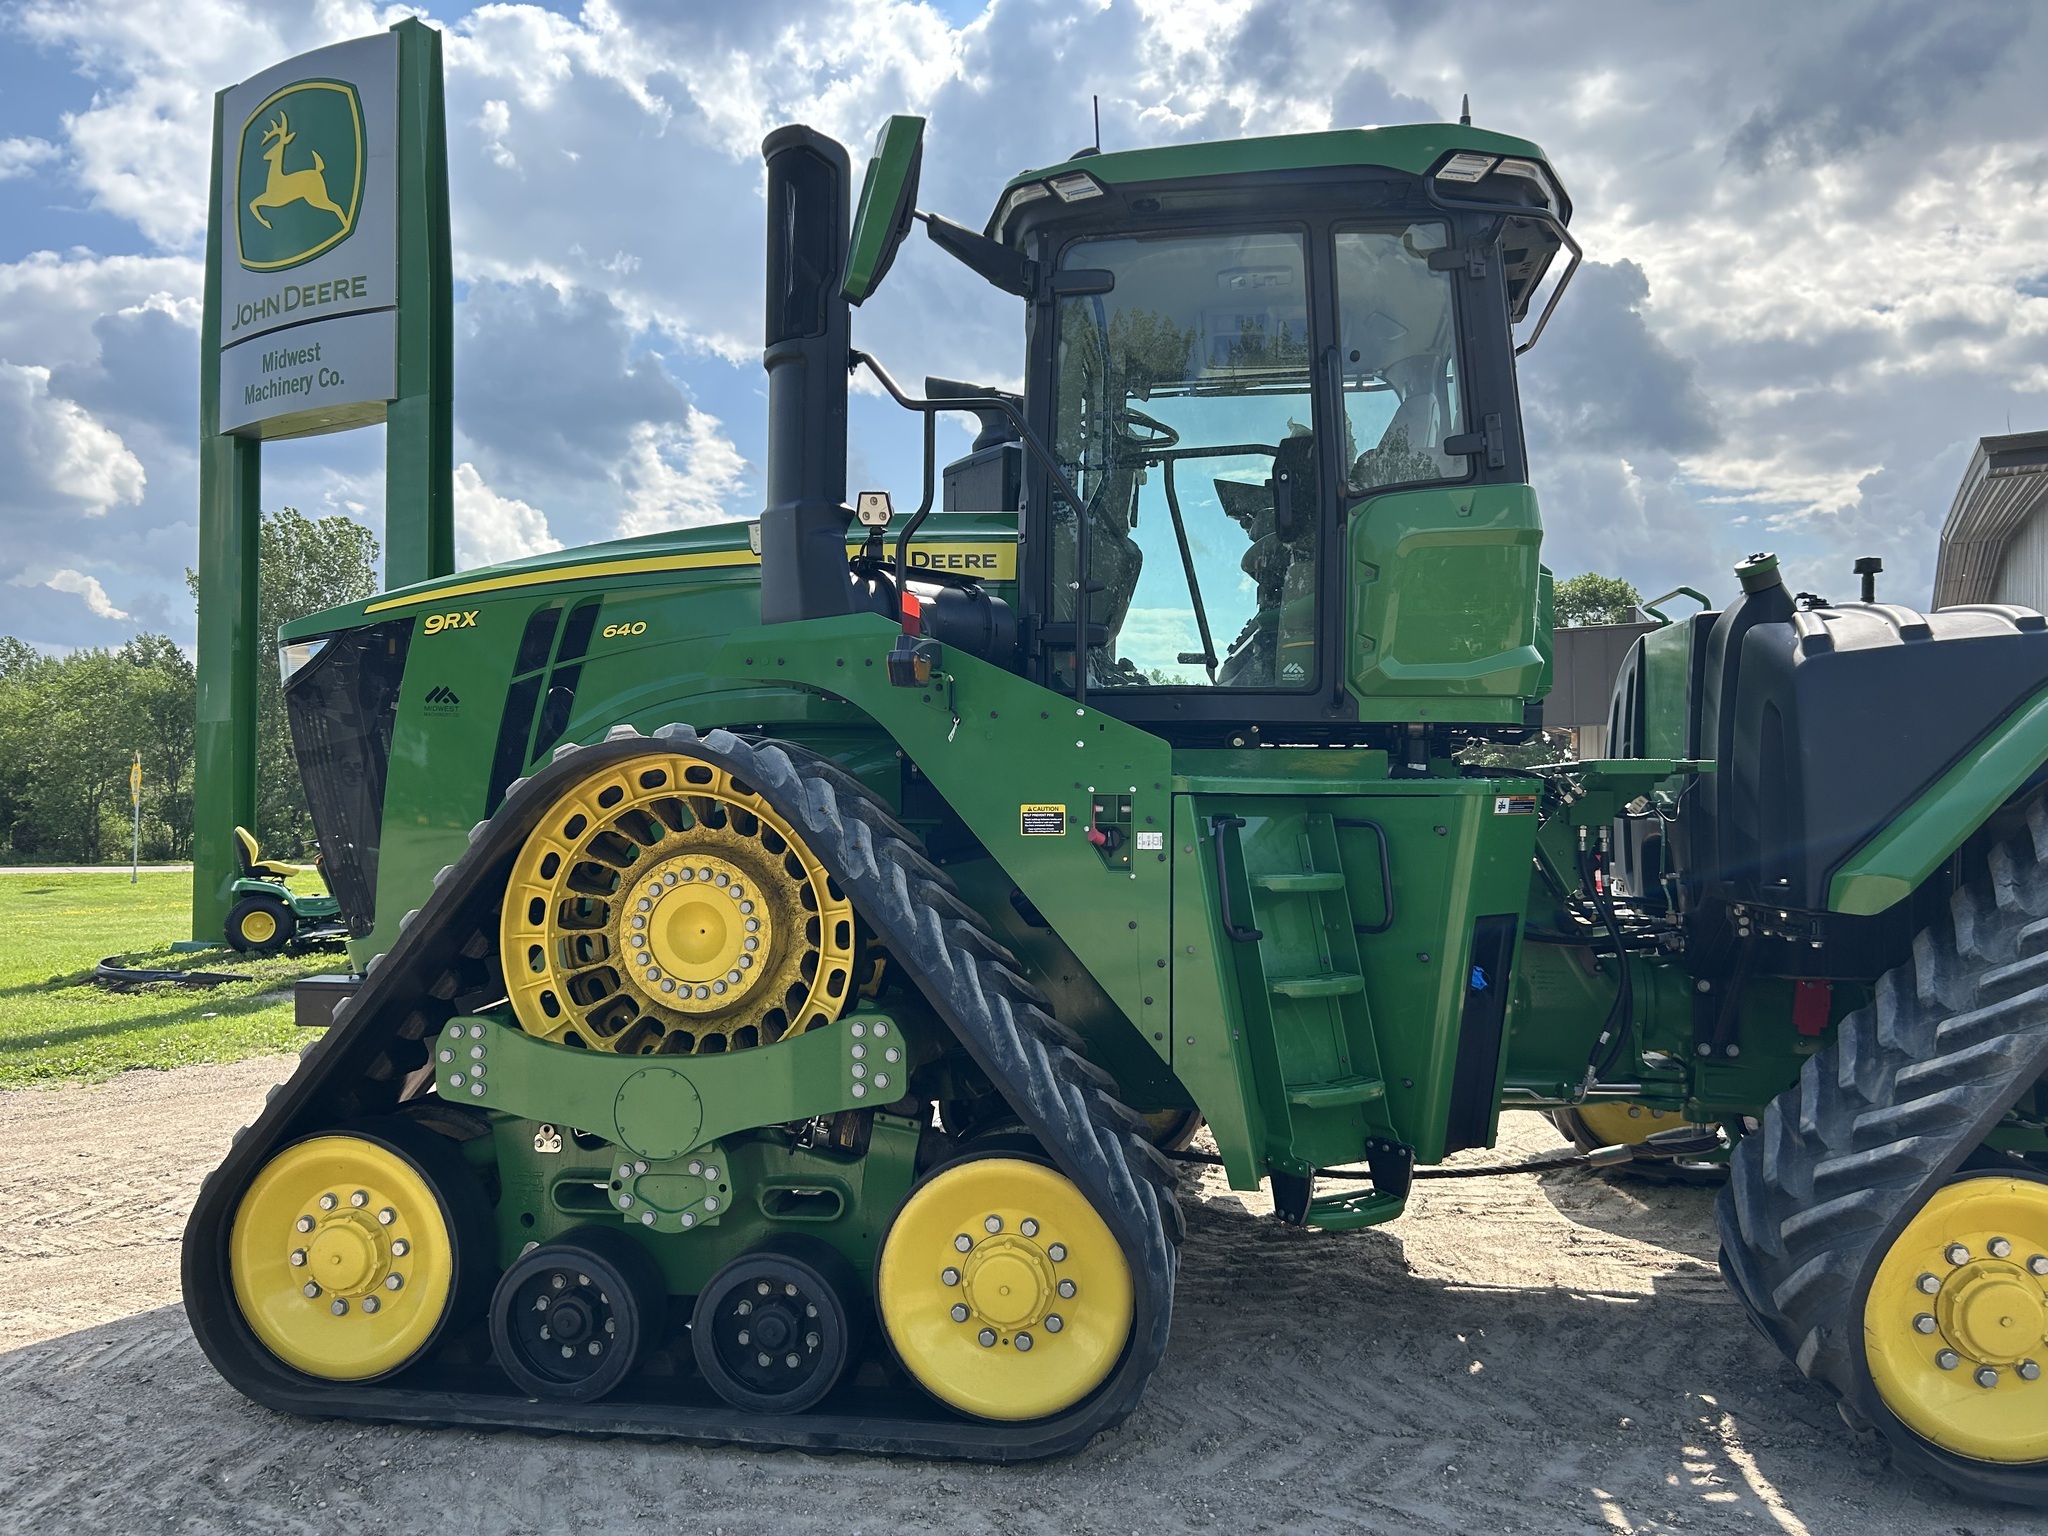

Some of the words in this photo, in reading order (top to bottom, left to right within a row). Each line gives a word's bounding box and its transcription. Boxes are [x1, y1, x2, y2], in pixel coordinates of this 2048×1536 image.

[231, 294, 280, 331] JOHN
[284, 275, 367, 312] DEERE
[262, 342, 321, 374] Midwest
[244, 374, 313, 405] Machinery
[318, 367, 345, 388] Co.
[911, 551, 998, 569] DEERE
[424, 610, 481, 636] 9RX
[602, 621, 647, 638] 640
